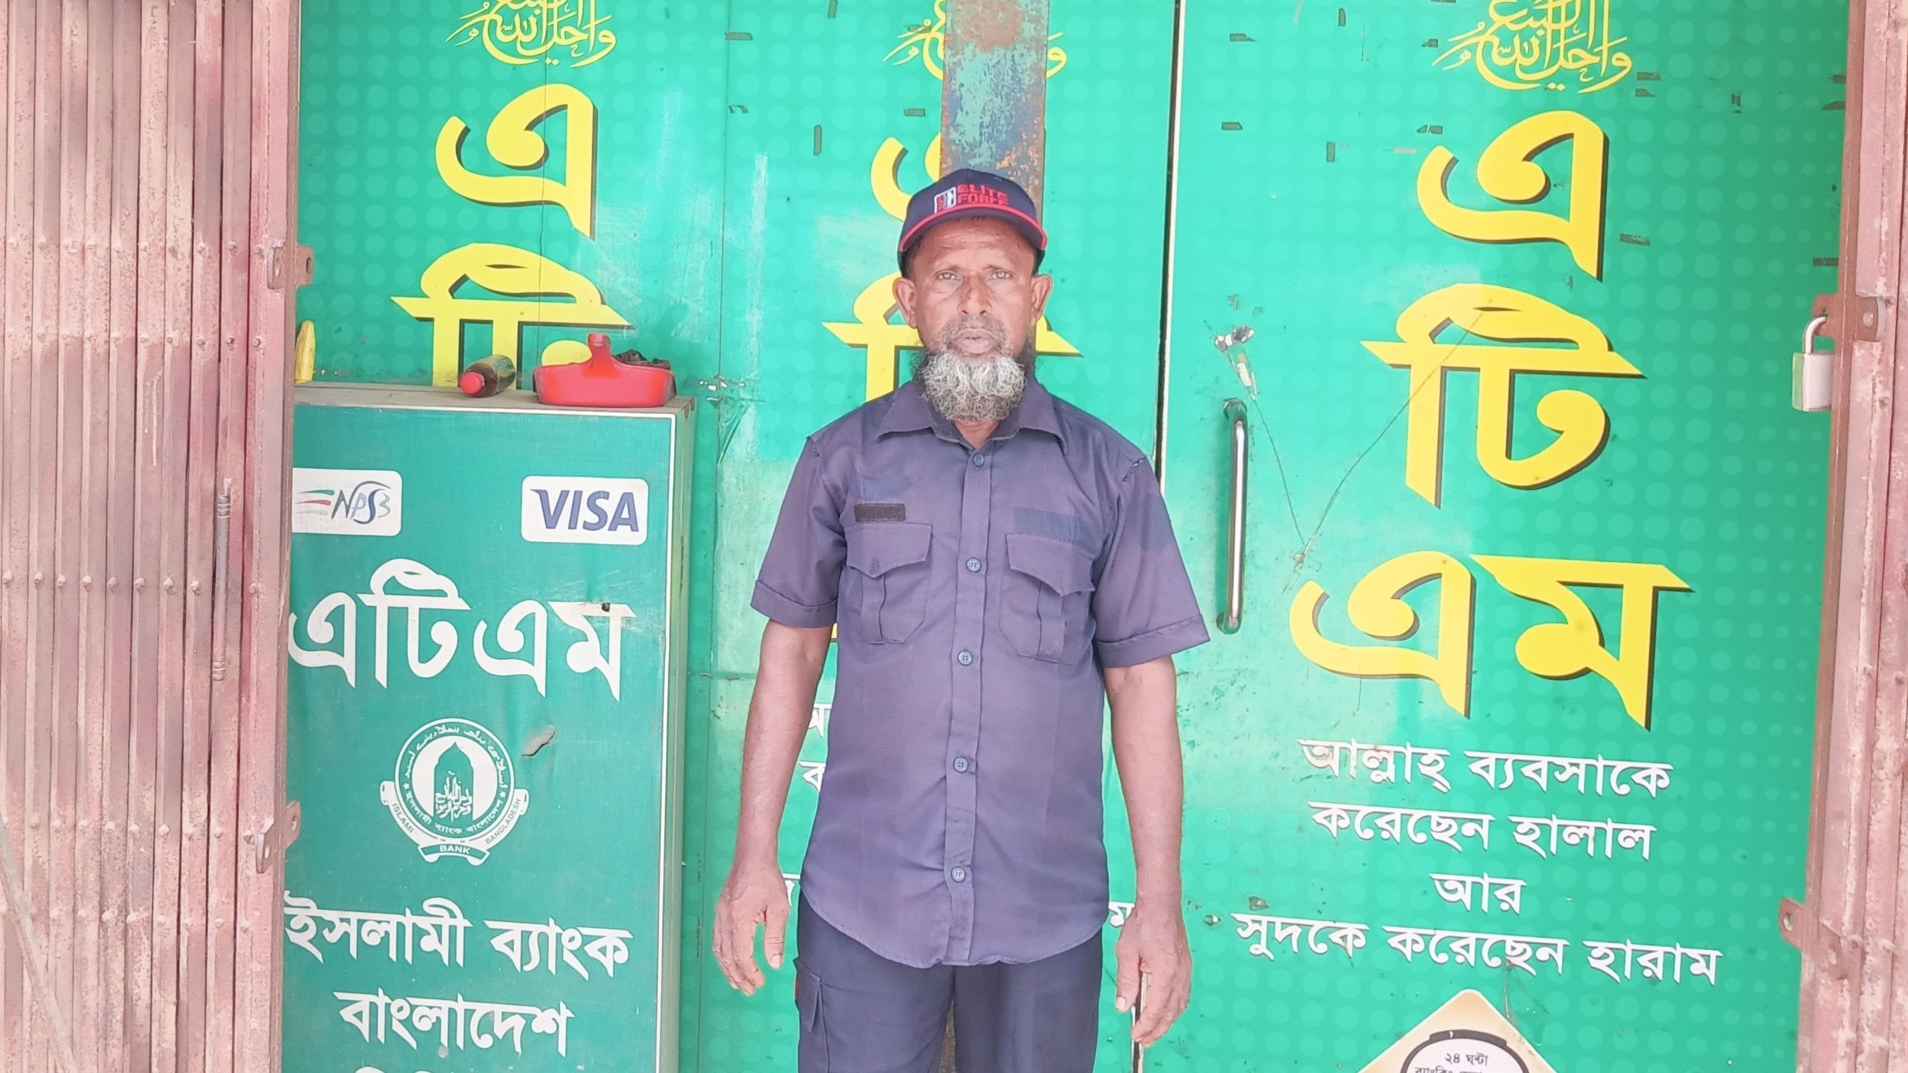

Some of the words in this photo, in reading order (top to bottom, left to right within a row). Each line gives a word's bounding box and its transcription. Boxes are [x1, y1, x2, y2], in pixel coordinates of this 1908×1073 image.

[436, 83, 597, 240] এ
[1418, 110, 1606, 282] এ
[1361, 283, 1648, 510] টি
[530, 488, 640, 533] VISA
[1289, 550, 1694, 731] এম
[1464, 751, 1674, 798] ব্যবসাকে
[439, 843, 471, 855] BANK
[1307, 800, 1496, 852] করেছেন
[1509, 814, 1657, 861] হালাল
[1430, 871, 1527, 914] আর
[282, 890, 474, 968] ইসলামী
[485, 917, 633, 981] ব্যাংক
[1231, 912, 1369, 960] সুদকে
[1383, 925, 1570, 976] করেছেন
[1582, 939, 1723, 986] হারাম
[333, 987, 576, 1058] বাংলাদেশ
